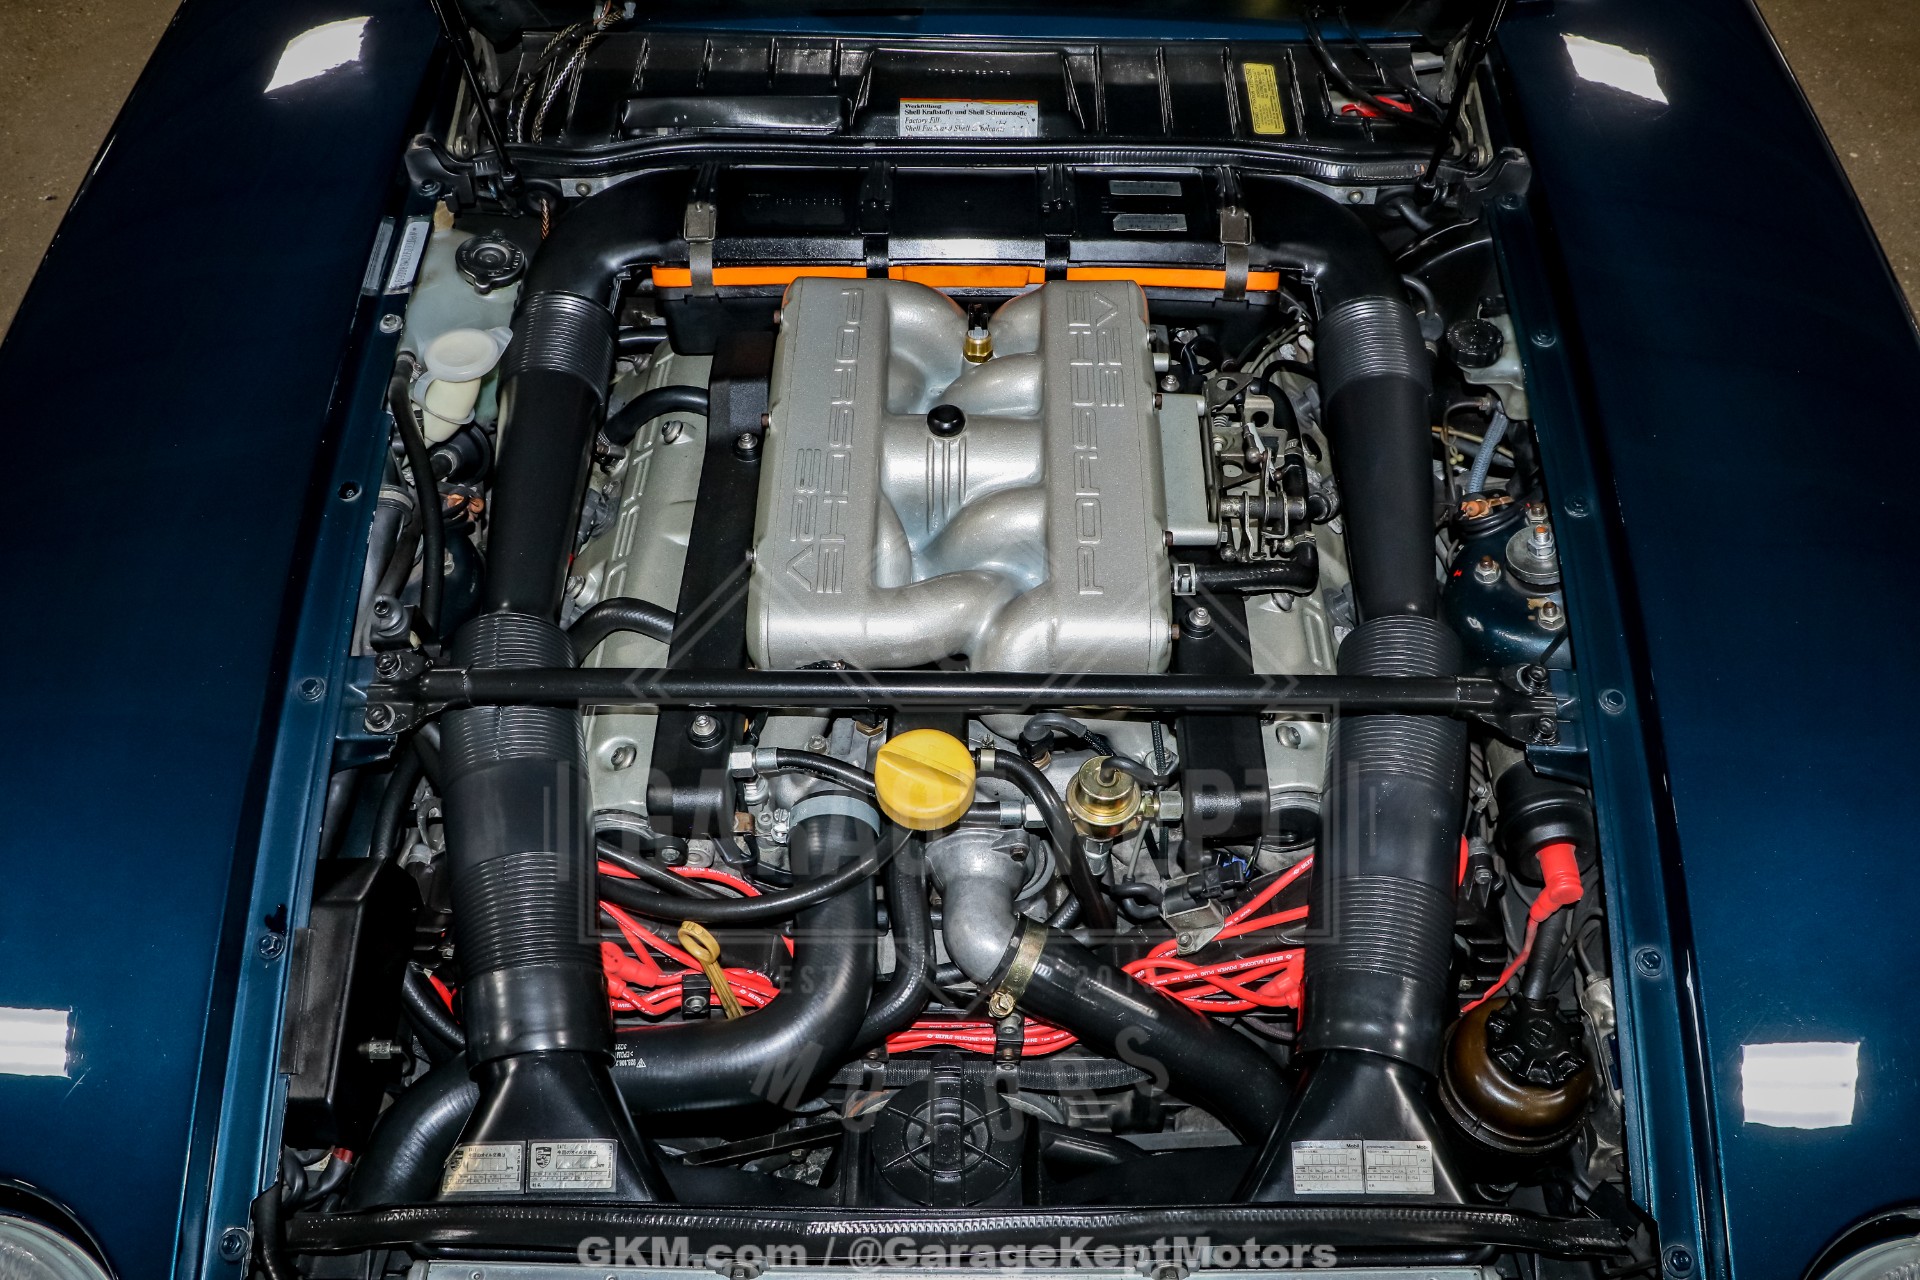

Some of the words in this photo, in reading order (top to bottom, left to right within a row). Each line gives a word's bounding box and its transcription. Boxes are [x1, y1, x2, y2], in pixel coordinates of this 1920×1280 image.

[1093, 290, 1126, 408] 32V
[817, 287, 863, 594] PORSCHE
[1066, 290, 1104, 596] PORSCHE
[785, 447, 822, 591] 32V
[1218, 965, 1238, 974] POWER
